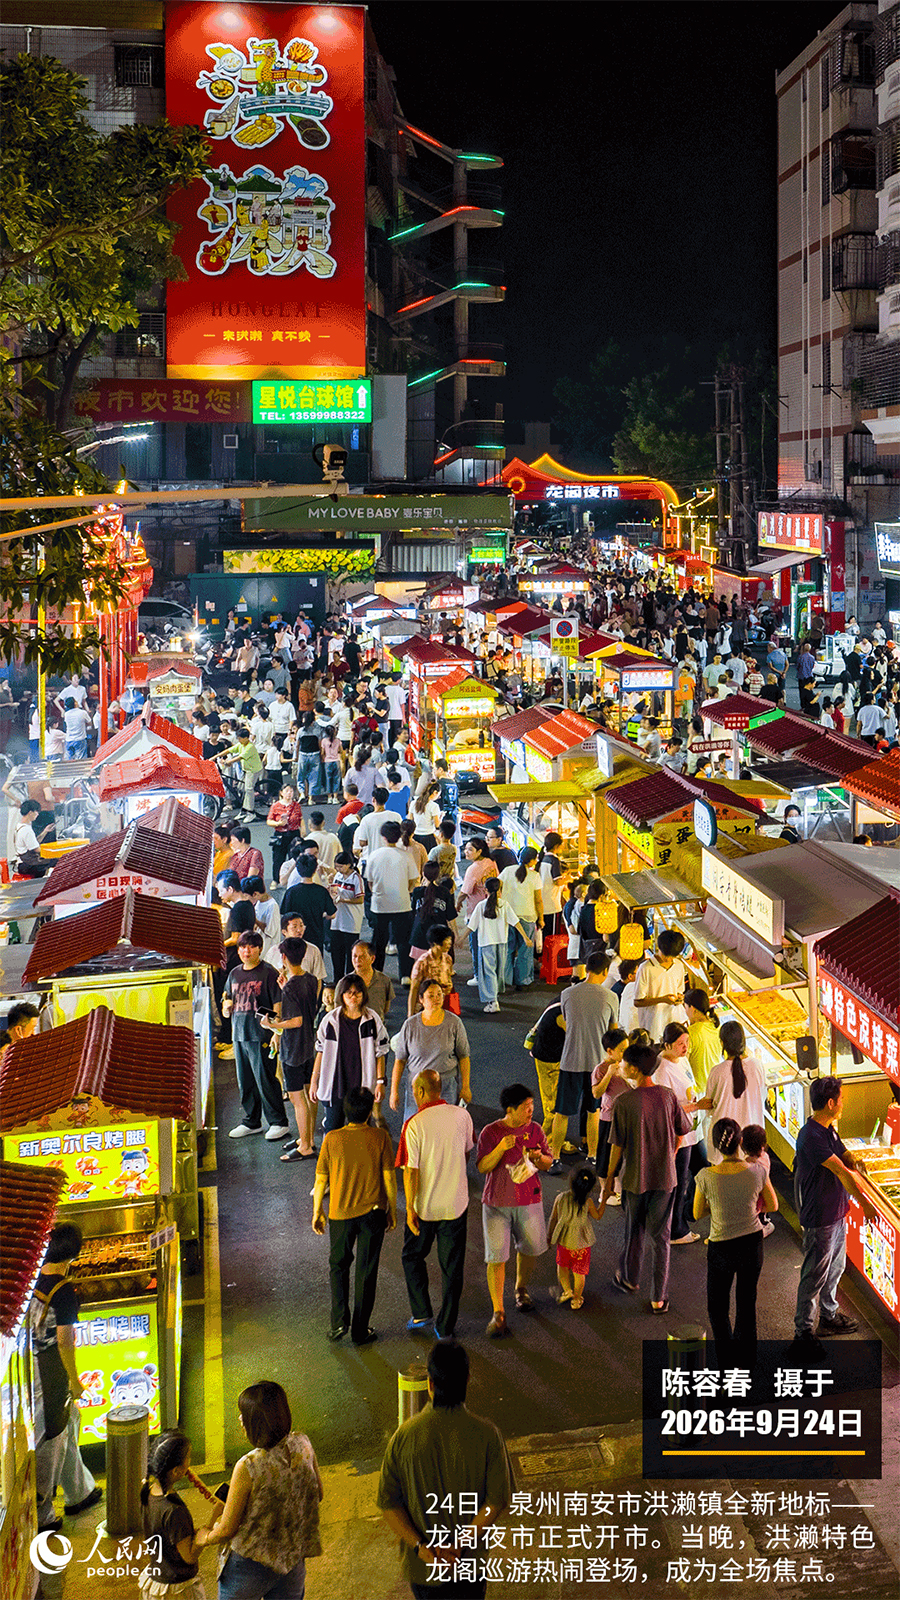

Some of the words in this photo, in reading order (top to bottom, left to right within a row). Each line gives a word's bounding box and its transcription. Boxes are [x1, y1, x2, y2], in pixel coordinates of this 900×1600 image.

[259, 385, 354, 410] 星悦台球馆
[259, 412, 285, 420] TEL:
[289, 411, 365, 420] 13599988322
[545, 485, 620, 499] 龙阁夜市
[308, 508, 328, 518] MY
[330, 508, 365, 518] LOVE
[367, 508, 400, 518] BABY
[18, 1129, 146, 1158] 新奥尔良烤腿
